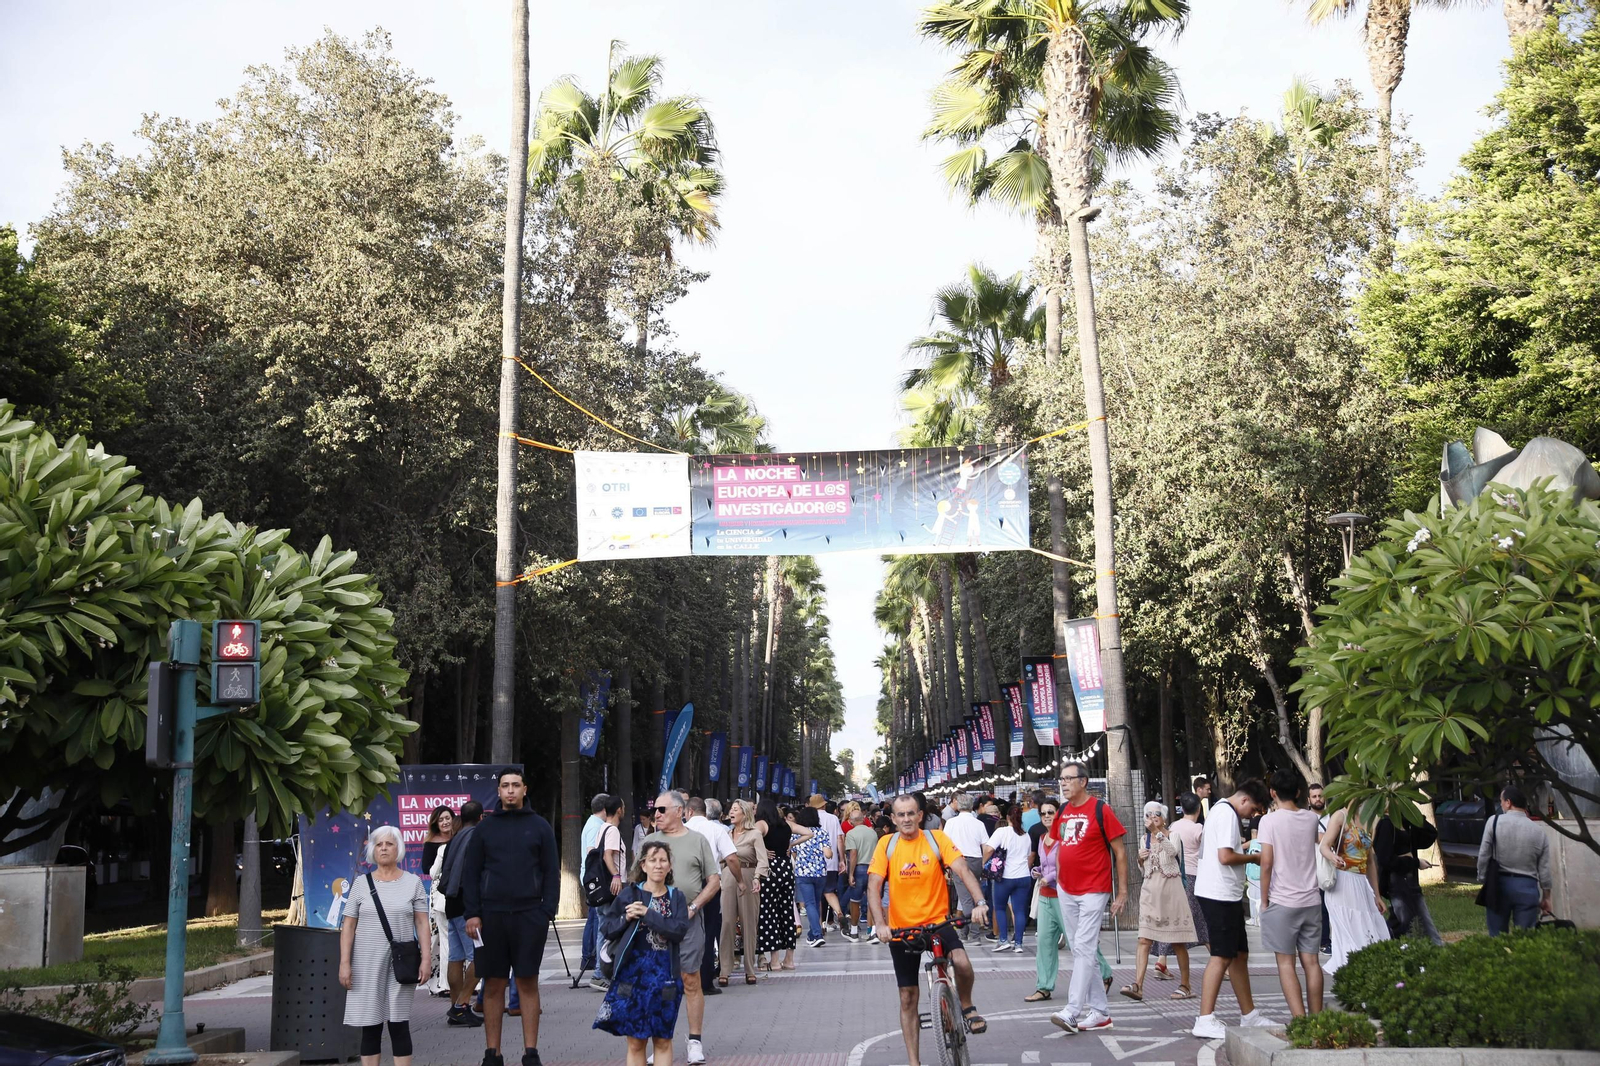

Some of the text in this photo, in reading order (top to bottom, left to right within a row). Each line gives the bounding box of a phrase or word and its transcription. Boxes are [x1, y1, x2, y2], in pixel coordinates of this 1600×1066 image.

[717, 467, 797, 481] LA NOCHE
[602, 483, 630, 492] OTRI
[718, 483, 847, 499] EUROPEA DE L@S
[718, 501, 847, 516] INVESTIGADOR@S
[1039, 678, 1044, 686] DE
[1035, 706, 1040, 714] LA
[401, 796, 468, 809] LA NOCHE
[410, 858, 421, 868] 27
